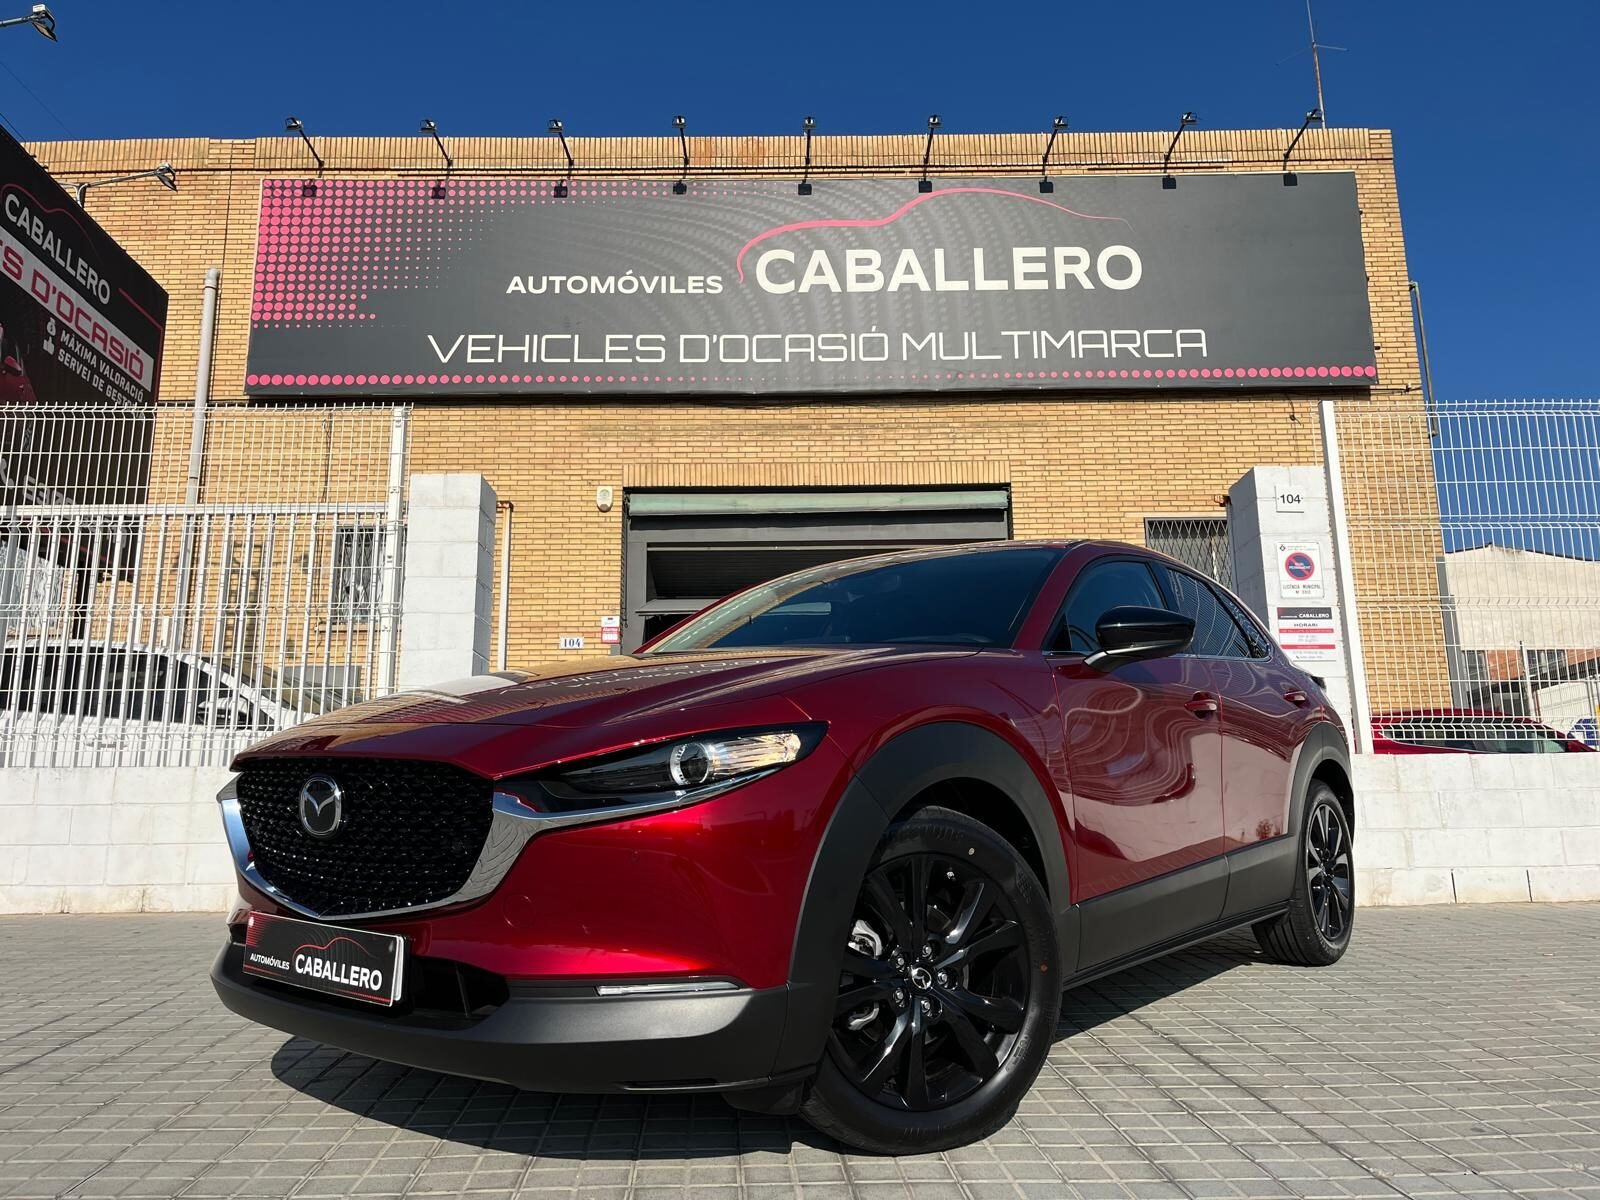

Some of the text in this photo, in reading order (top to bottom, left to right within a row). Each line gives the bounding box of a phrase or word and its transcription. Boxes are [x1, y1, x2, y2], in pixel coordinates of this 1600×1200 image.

[5, 193, 111, 305] CABALLERO
[506, 244, 1143, 295] AUTOMÓVILES CABALLERO
[31, 269, 144, 381] D'OCASIÓ
[427, 325, 1208, 364] VEHICLES D'OCASIÓ MULTIMARCA
[57, 348, 90, 382] SERVEI
[92, 375, 104, 391] DE
[99, 359, 144, 403] VALORACIÓ
[1279, 493, 1302, 504] 104
[564, 638, 581, 648] 104
[250, 952, 383, 991] AUTOMÓVILES CABALLERO
